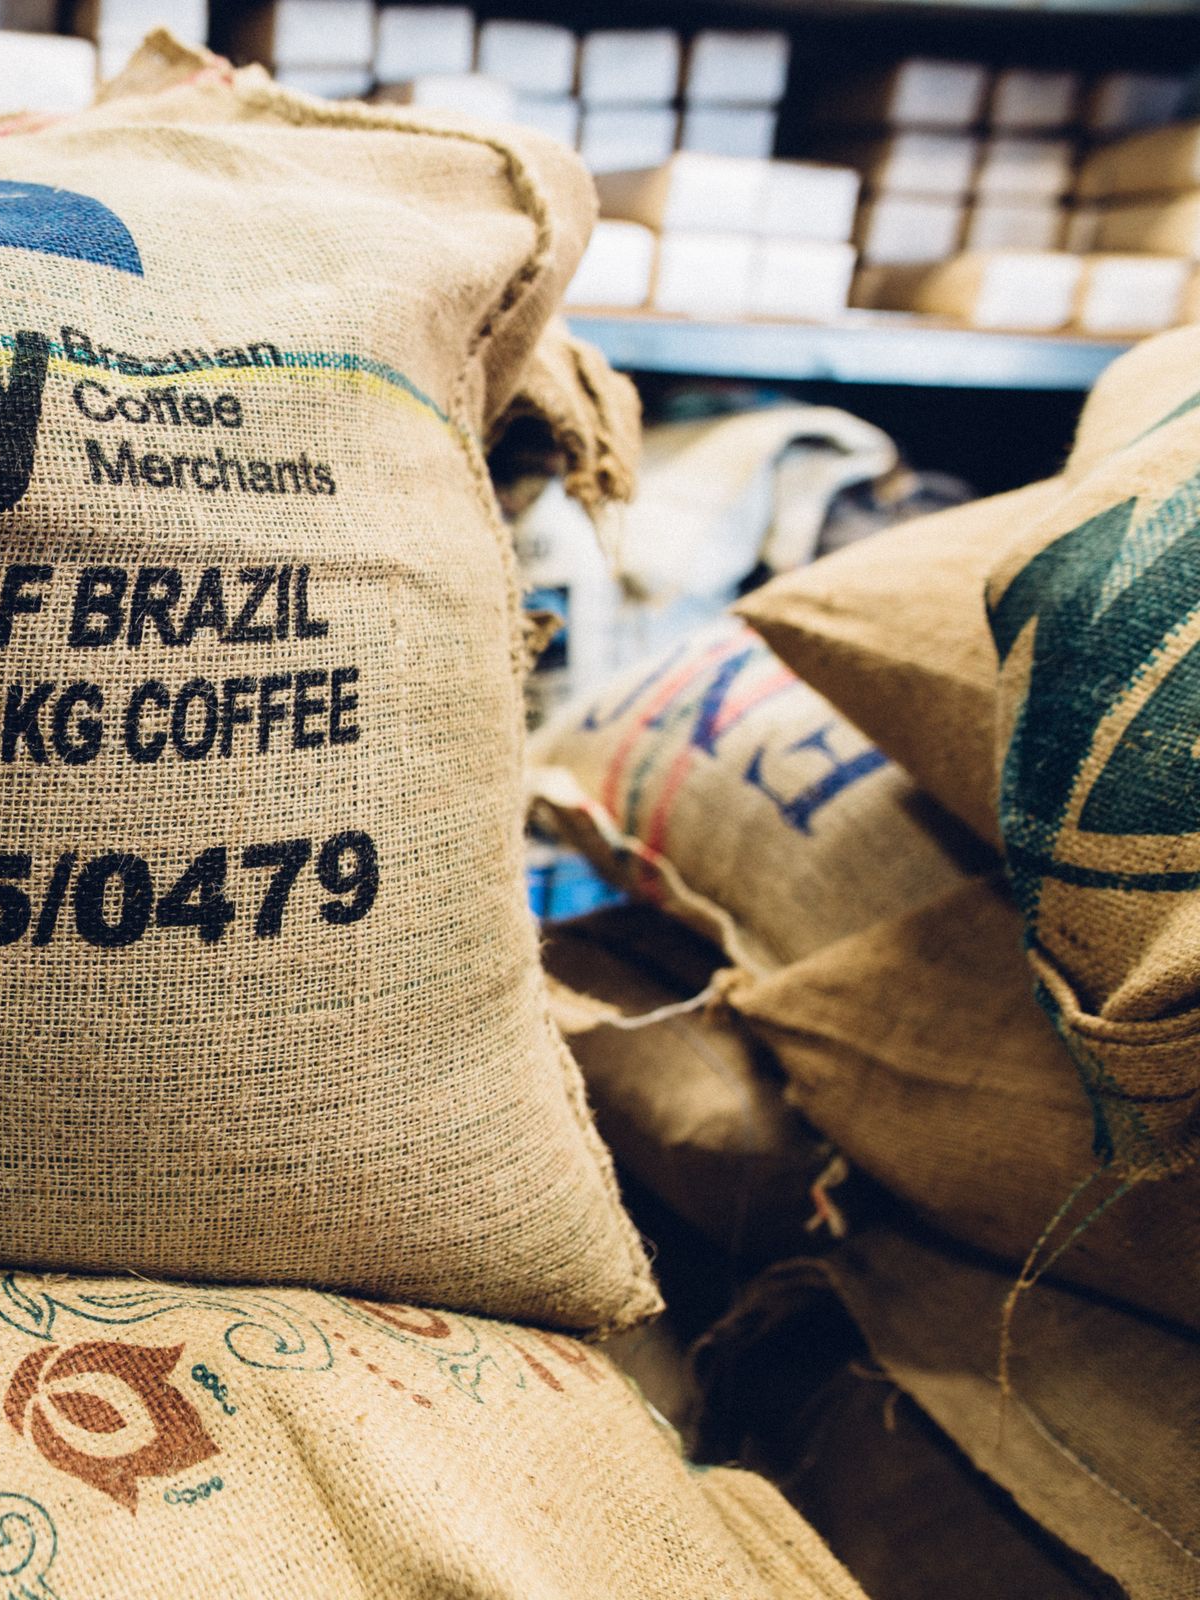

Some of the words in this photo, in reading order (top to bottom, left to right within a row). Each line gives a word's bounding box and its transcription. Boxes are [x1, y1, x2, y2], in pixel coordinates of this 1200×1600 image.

[73, 379, 244, 428] Coffee
[85, 439, 336, 496] Merchants
[69, 564, 329, 648] BRAZIL
[1, 679, 104, 765] KG
[126, 666, 360, 764] COFFEE
